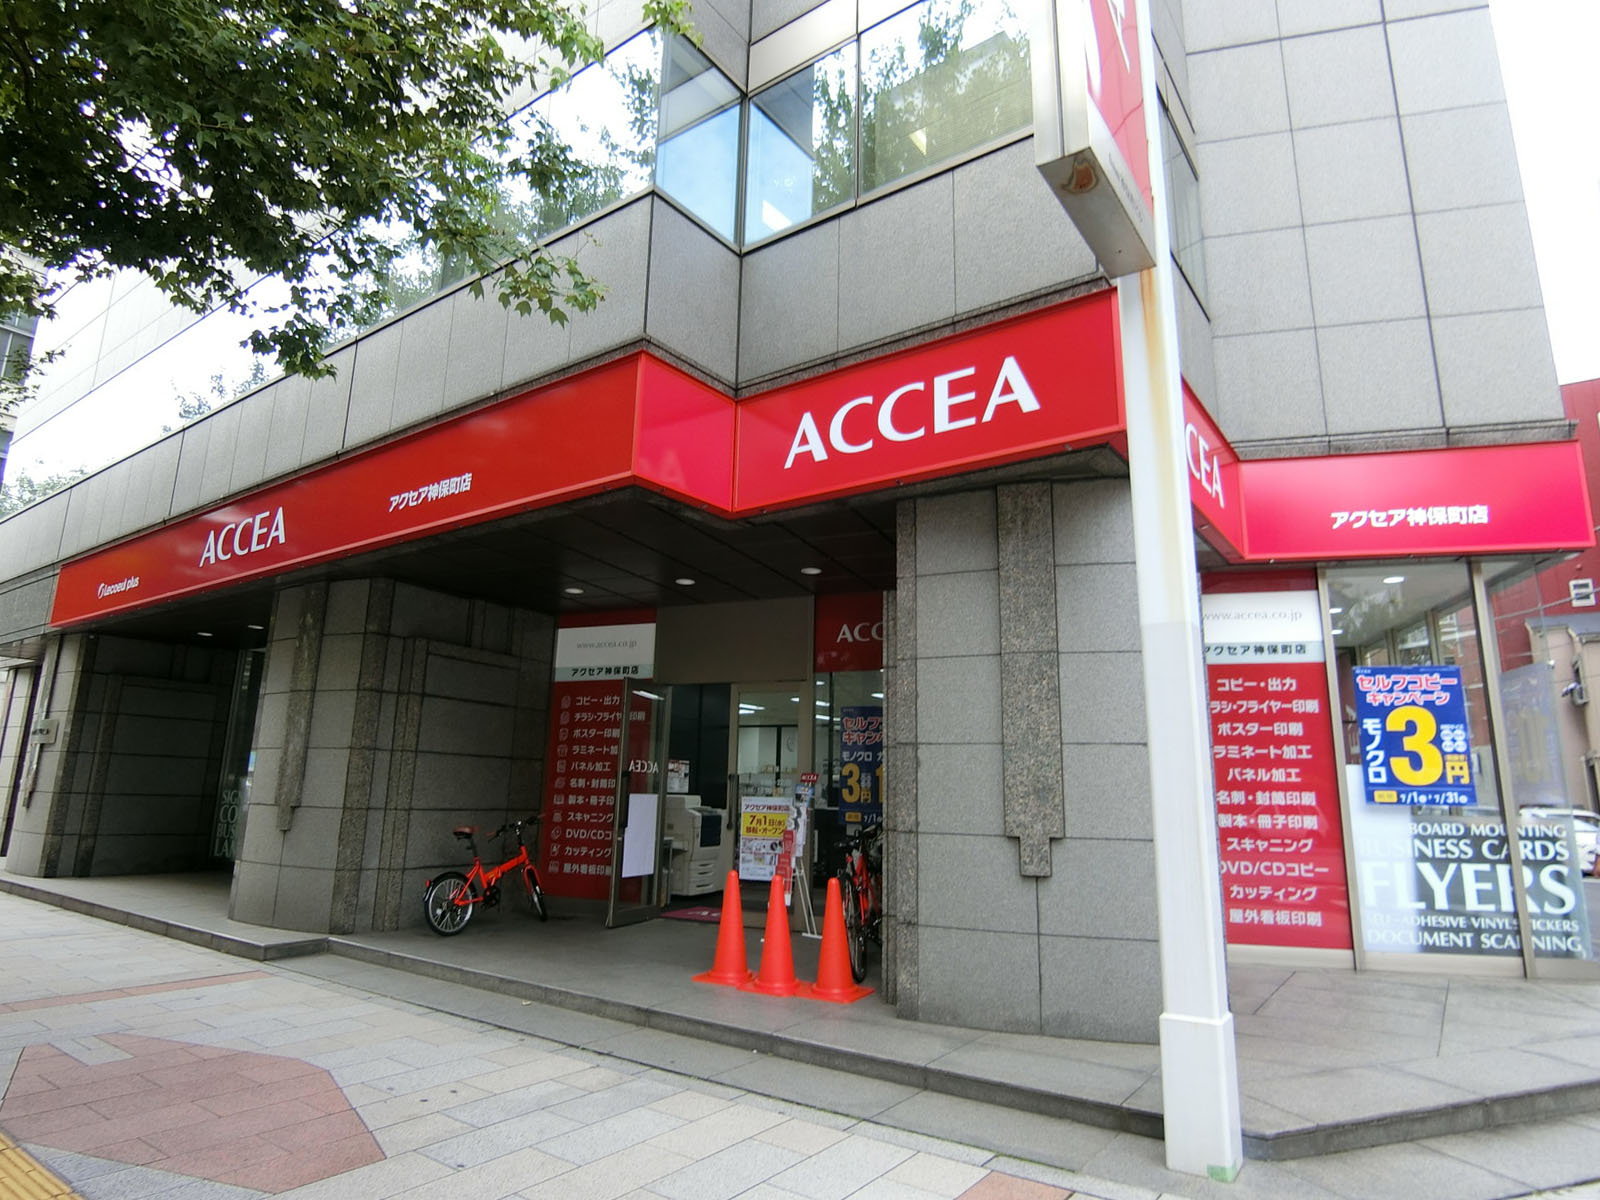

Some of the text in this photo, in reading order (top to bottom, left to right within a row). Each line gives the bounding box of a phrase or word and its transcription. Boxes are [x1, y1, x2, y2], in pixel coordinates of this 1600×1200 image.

[784, 355, 1041, 469] ACCEA
[1185, 423, 1225, 509] CEA
[388, 473, 472, 512] アクセア神保町店
[1330, 505, 1489, 530] アクセア神保町店
[199, 506, 285, 567] ACCEA
[572, 665, 639, 677] アクセア神保町店
[1216, 677, 1297, 692] コピー・出力
[1356, 673, 1458, 691] セルフコピー
[575, 695, 620, 706] コピー・出力
[1366, 690, 1450, 706] キャンペーン
[574, 711, 646, 722] チラシ・フライヤ印刷
[843, 717, 883, 730] セルフ
[573, 728, 620, 738] ポスター印刷
[1217, 721, 1304, 737] ポスター印刷
[1213, 744, 1313, 759] ラミネート加工
[1362, 718, 1387, 784] モノクロ
[1386, 705, 1444, 786] 3
[841, 751, 873, 761] モノクロ
[570, 761, 612, 772] パネル加工
[1445, 761, 1471, 784] 円
[841, 763, 860, 803] 3
[1227, 767, 1302, 783] パネル加工
[1216, 790, 1316, 806] 名刺・封筒印刷
[567, 811, 614, 823] スキャニング
[1218, 813, 1318, 830] 製本・冊子印刷
[1409, 822, 1465, 836] BOARD
[564, 845, 612, 858] カッティング
[1226, 837, 1313, 853] スキャニング
[1220, 860, 1329, 877] DVD/CDコピー
[1230, 884, 1317, 901] カッティング
[1361, 862, 1576, 915] FLYERS
[1229, 908, 1322, 927] 屋外看板印刷
[1513, 918, 1579, 933] SICKERS
[1367, 929, 1474, 948] DOCUMENT
